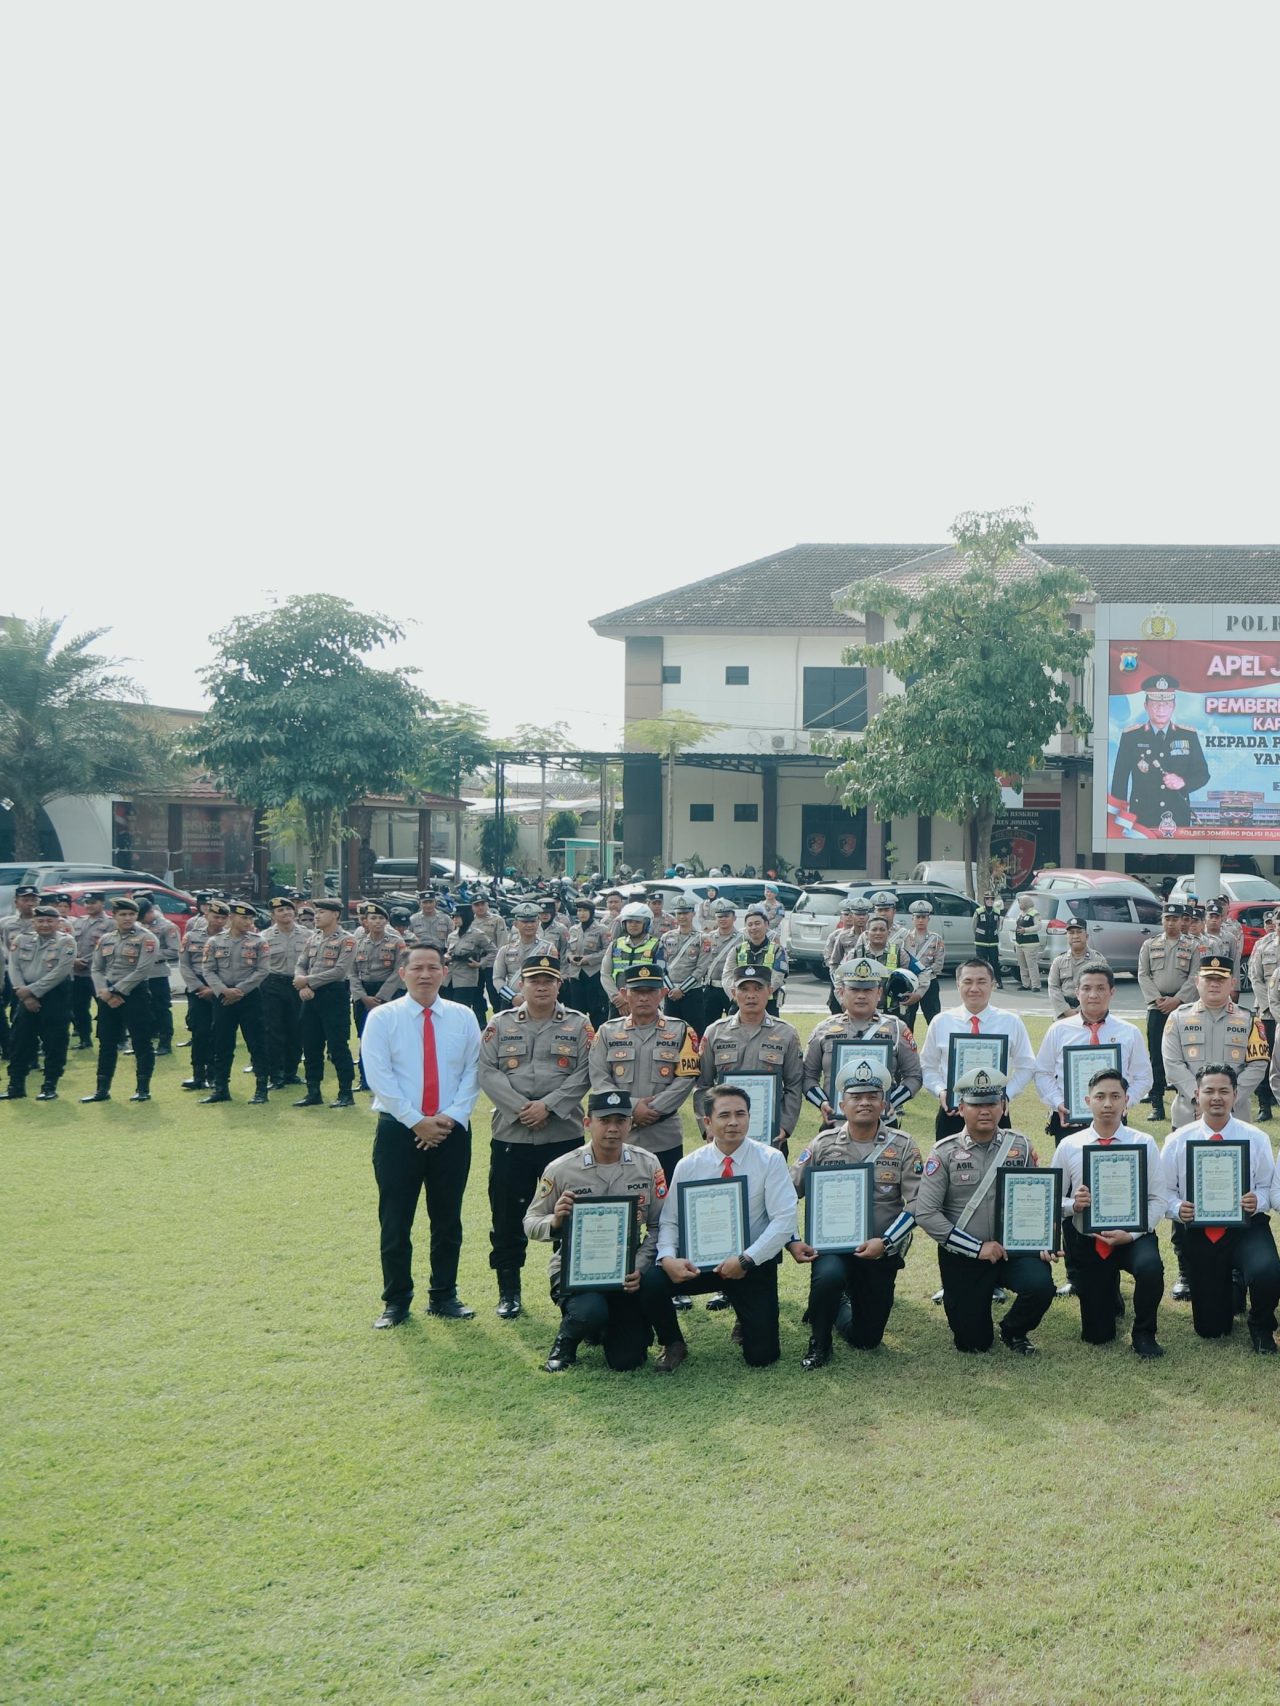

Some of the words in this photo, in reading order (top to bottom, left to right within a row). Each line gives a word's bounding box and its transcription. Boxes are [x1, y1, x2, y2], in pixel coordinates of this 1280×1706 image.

[1206, 655, 1266, 677] APEL
[1205, 736, 1269, 749] KEPADA
[1226, 1026, 1247, 1034] POLRI
[656, 1040, 679, 1048] POLRI
[1247, 1044, 1259, 1058] KA
[876, 1160, 899, 1168] POLRI
[627, 1183, 648, 1191] POLRI
